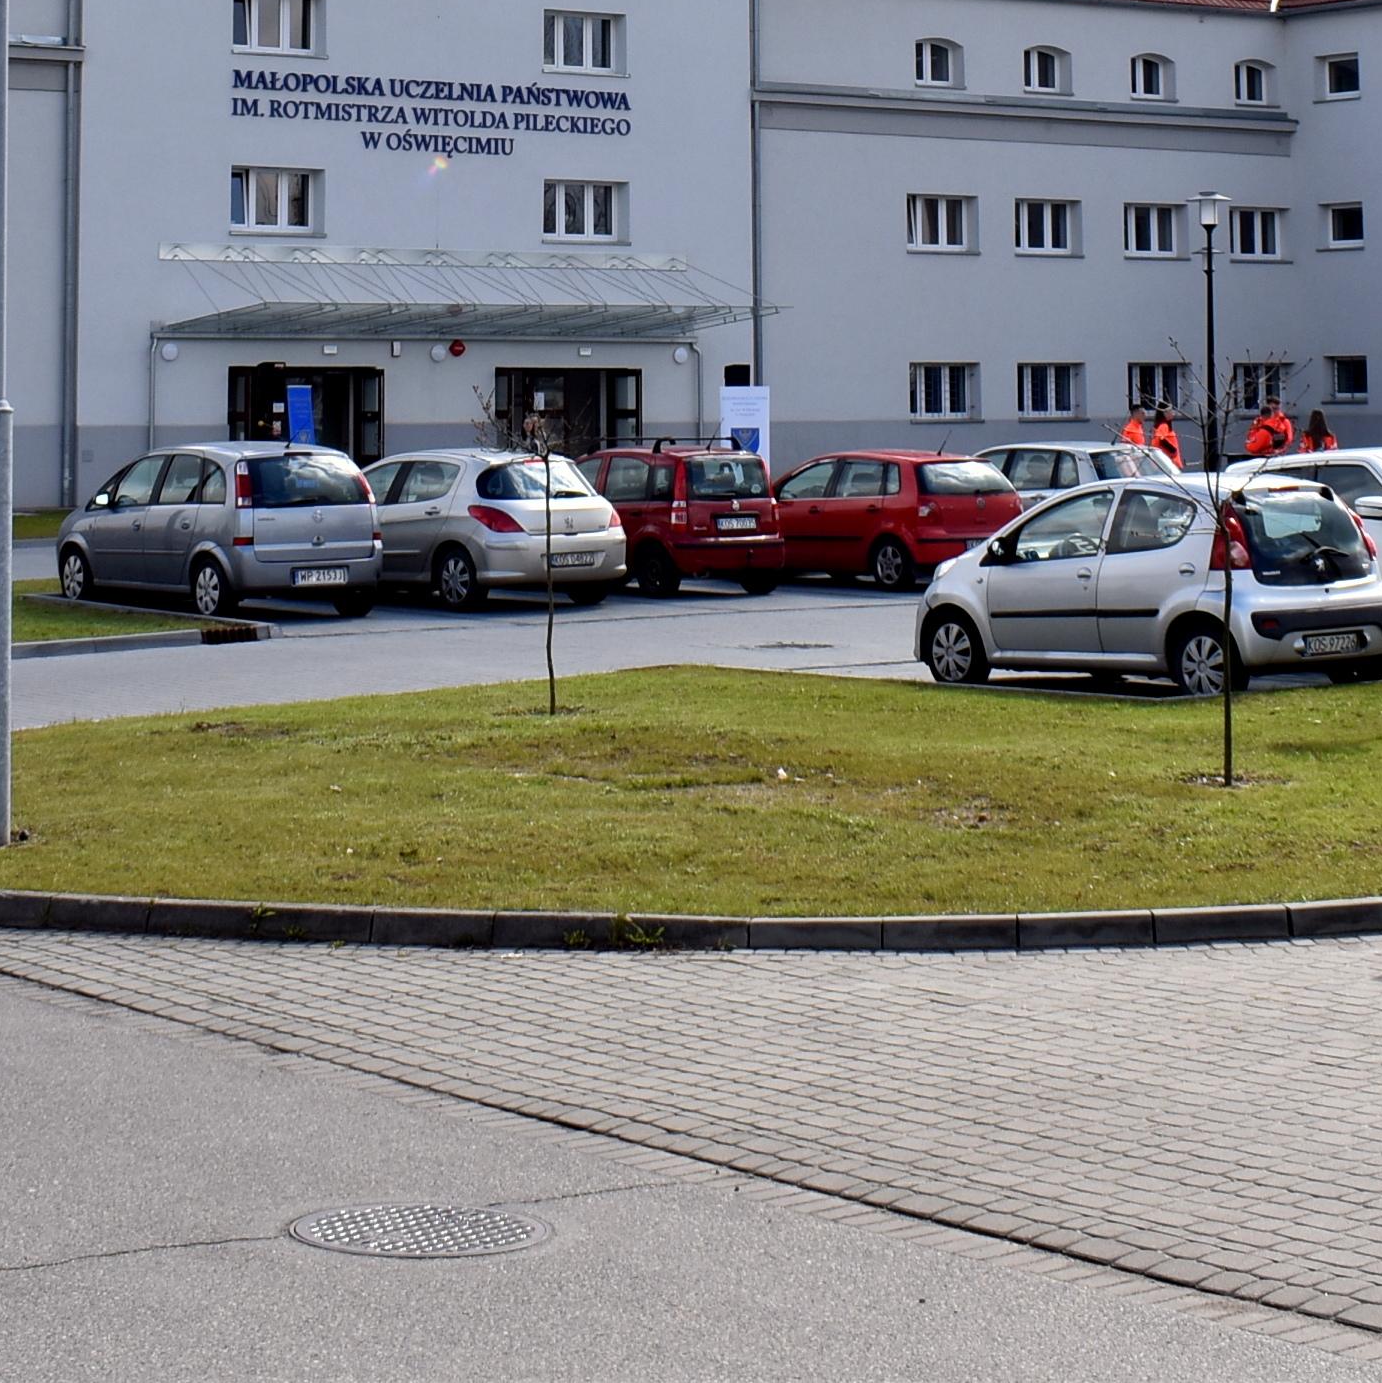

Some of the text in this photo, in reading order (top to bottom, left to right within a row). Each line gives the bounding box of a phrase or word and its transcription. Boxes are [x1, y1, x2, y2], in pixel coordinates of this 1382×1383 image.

[232, 69, 631, 111] MAŁOPOLSKA UCZELNIA PAŃSTWOWA
[231, 97, 632, 136] IM. ROTMISTRZA WITOLDA PILECKIEGO
[361, 128, 515, 158] W OŚWIĘCIMIU
[1307, 636, 1327, 652] KOS
